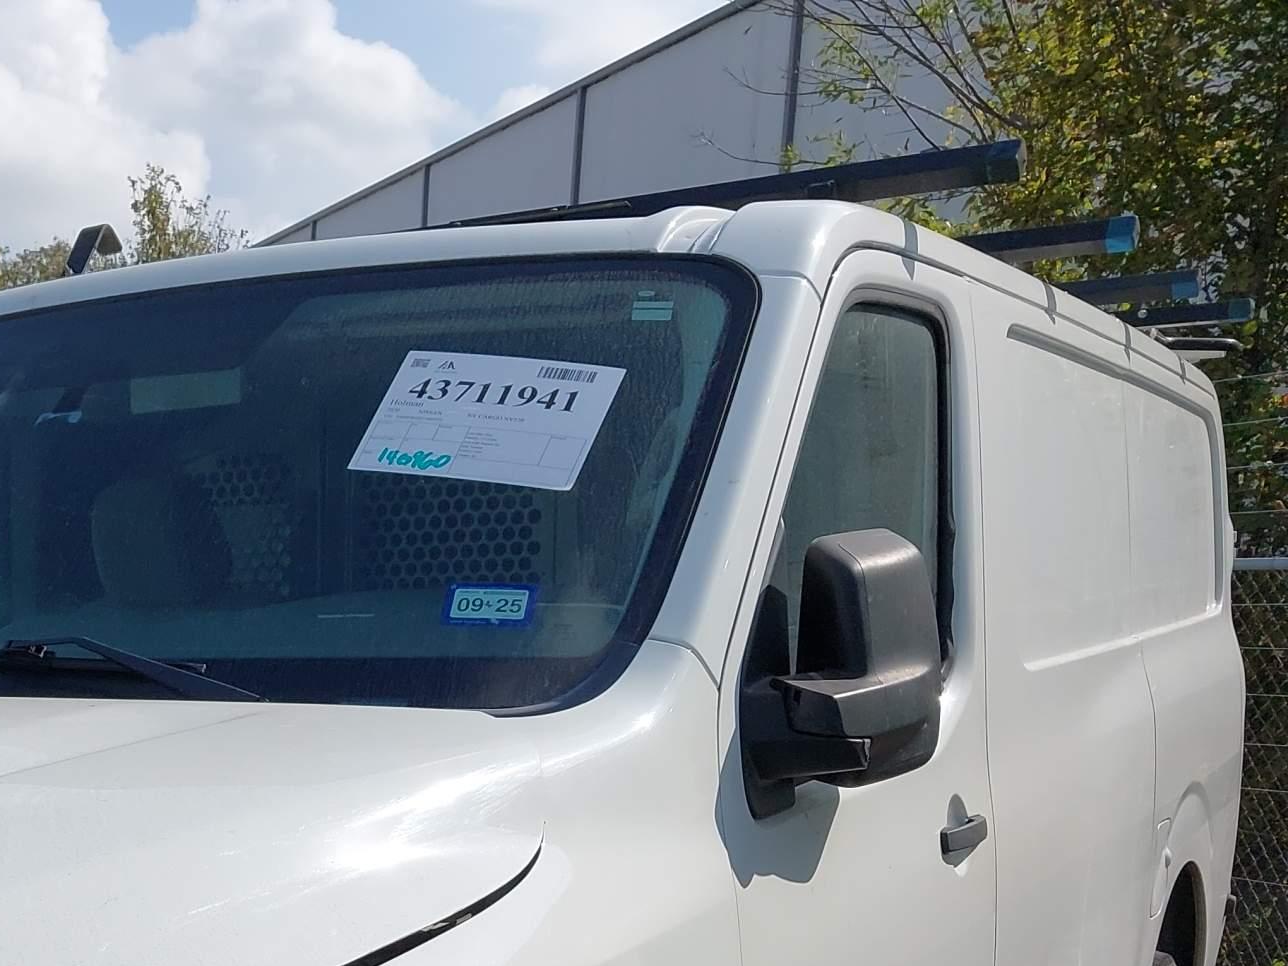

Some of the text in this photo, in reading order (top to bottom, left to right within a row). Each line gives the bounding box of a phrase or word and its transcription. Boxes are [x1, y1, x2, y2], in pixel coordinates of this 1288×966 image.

[409, 377, 580, 413] 43711941
[457, 597, 523, 613] 09 25
